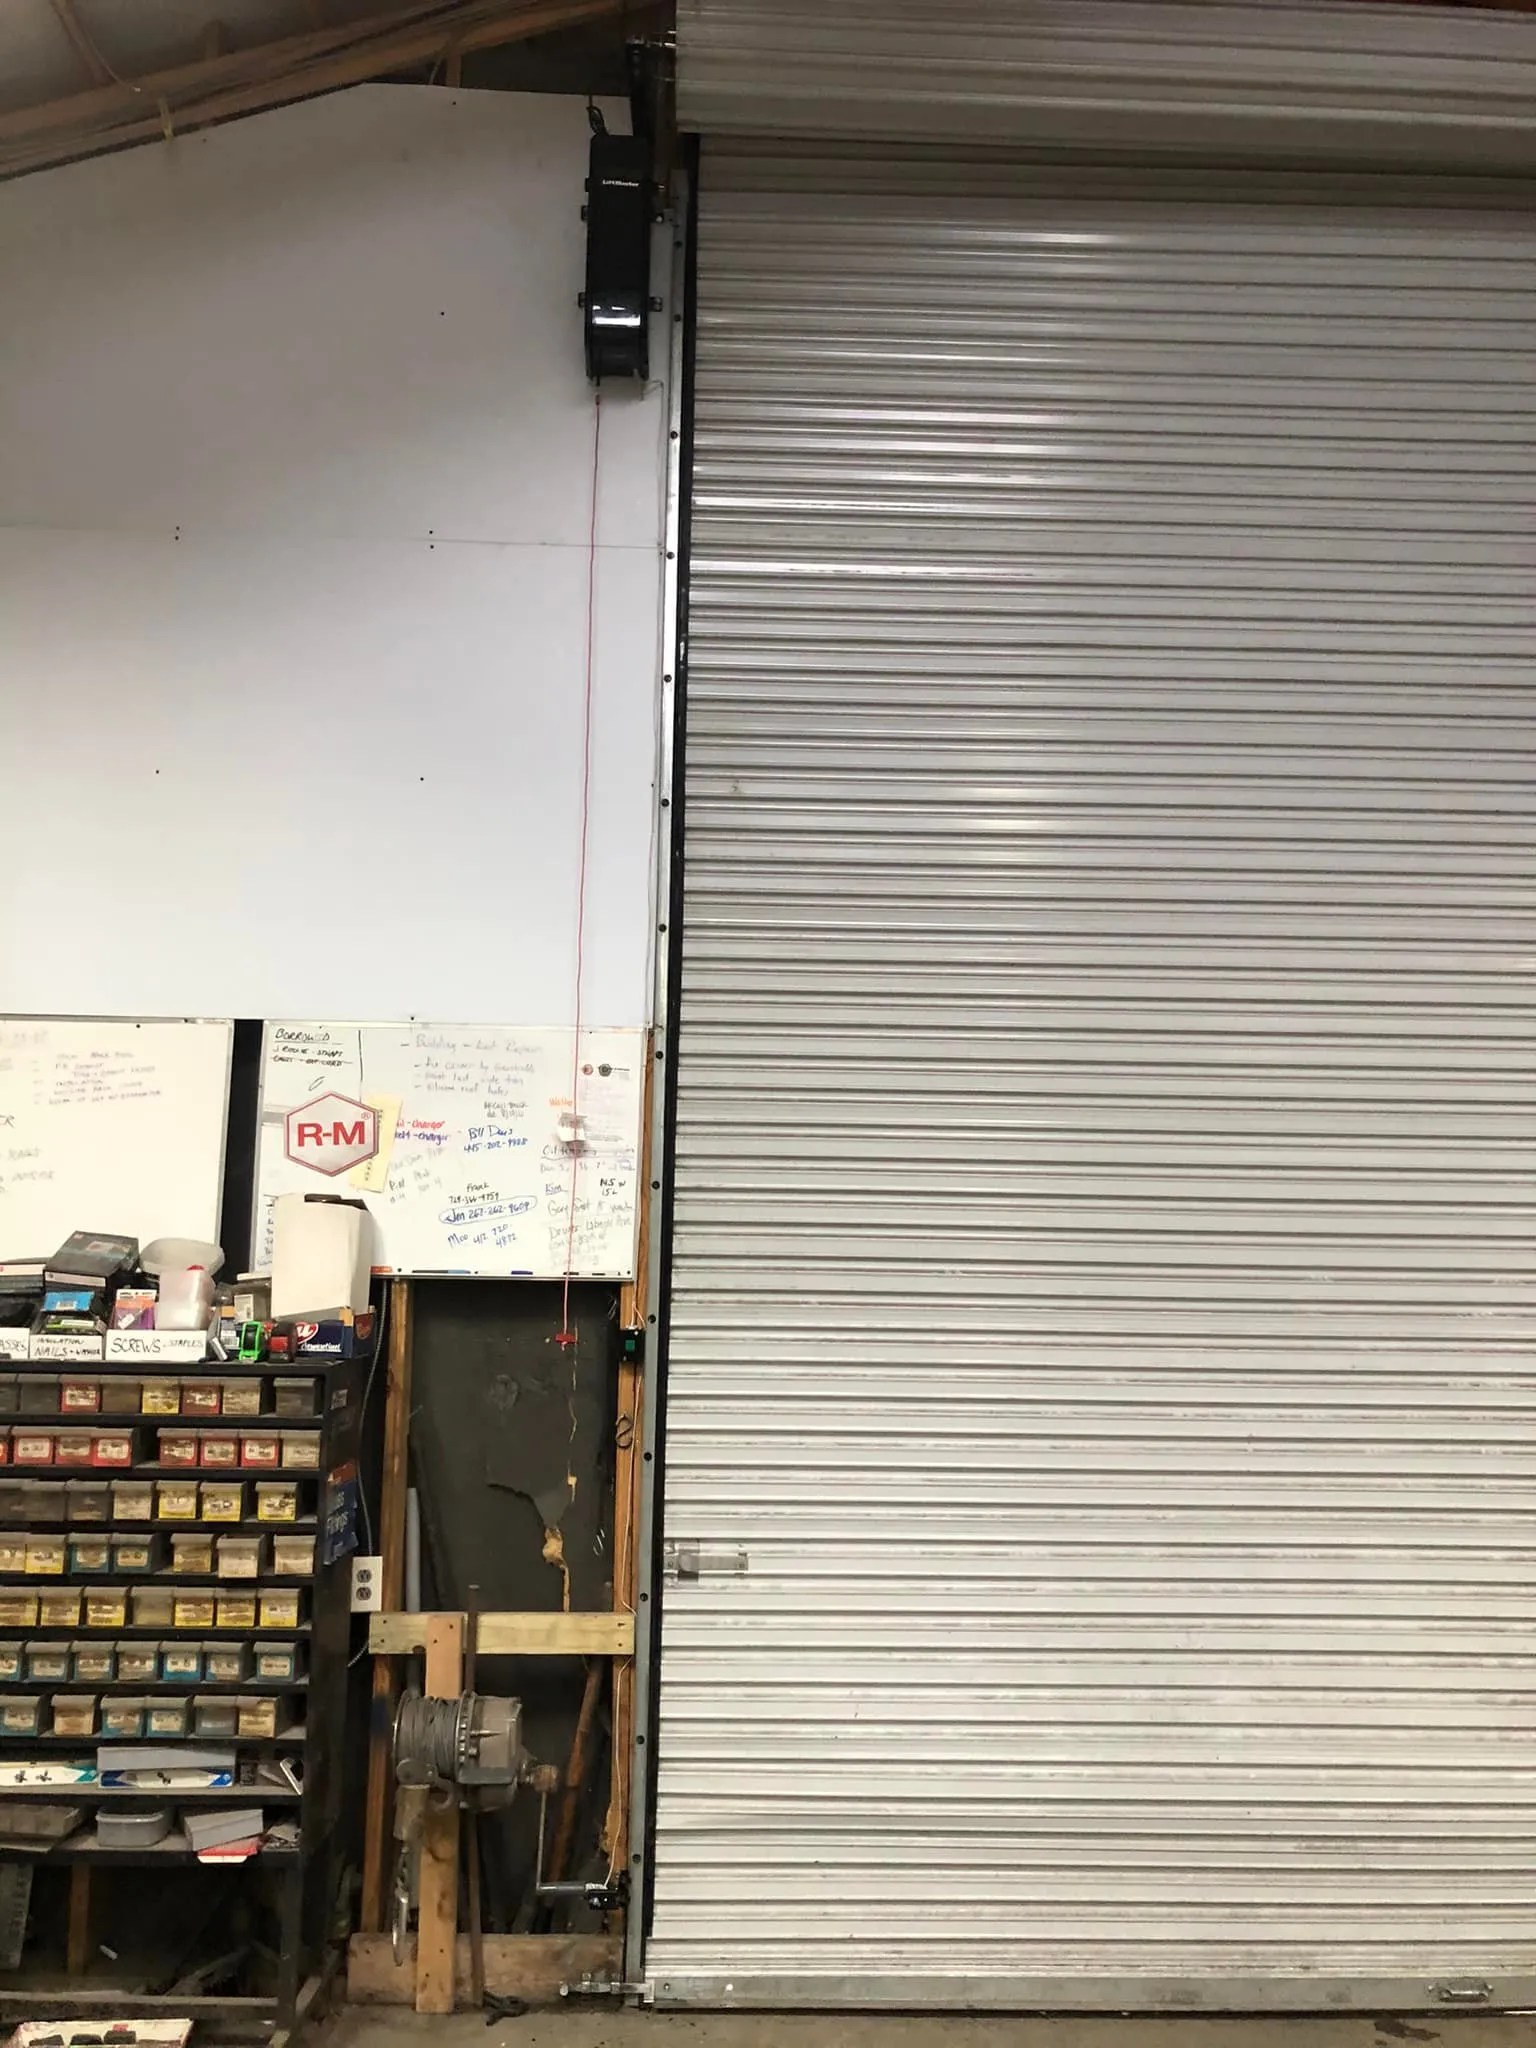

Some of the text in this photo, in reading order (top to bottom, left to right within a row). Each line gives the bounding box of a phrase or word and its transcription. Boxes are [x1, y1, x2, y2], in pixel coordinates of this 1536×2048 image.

[297, 1121, 366, 1147] R-M
[34, 1346, 68, 1357] NAILS
[110, 1337, 161, 1354] SCREWS
